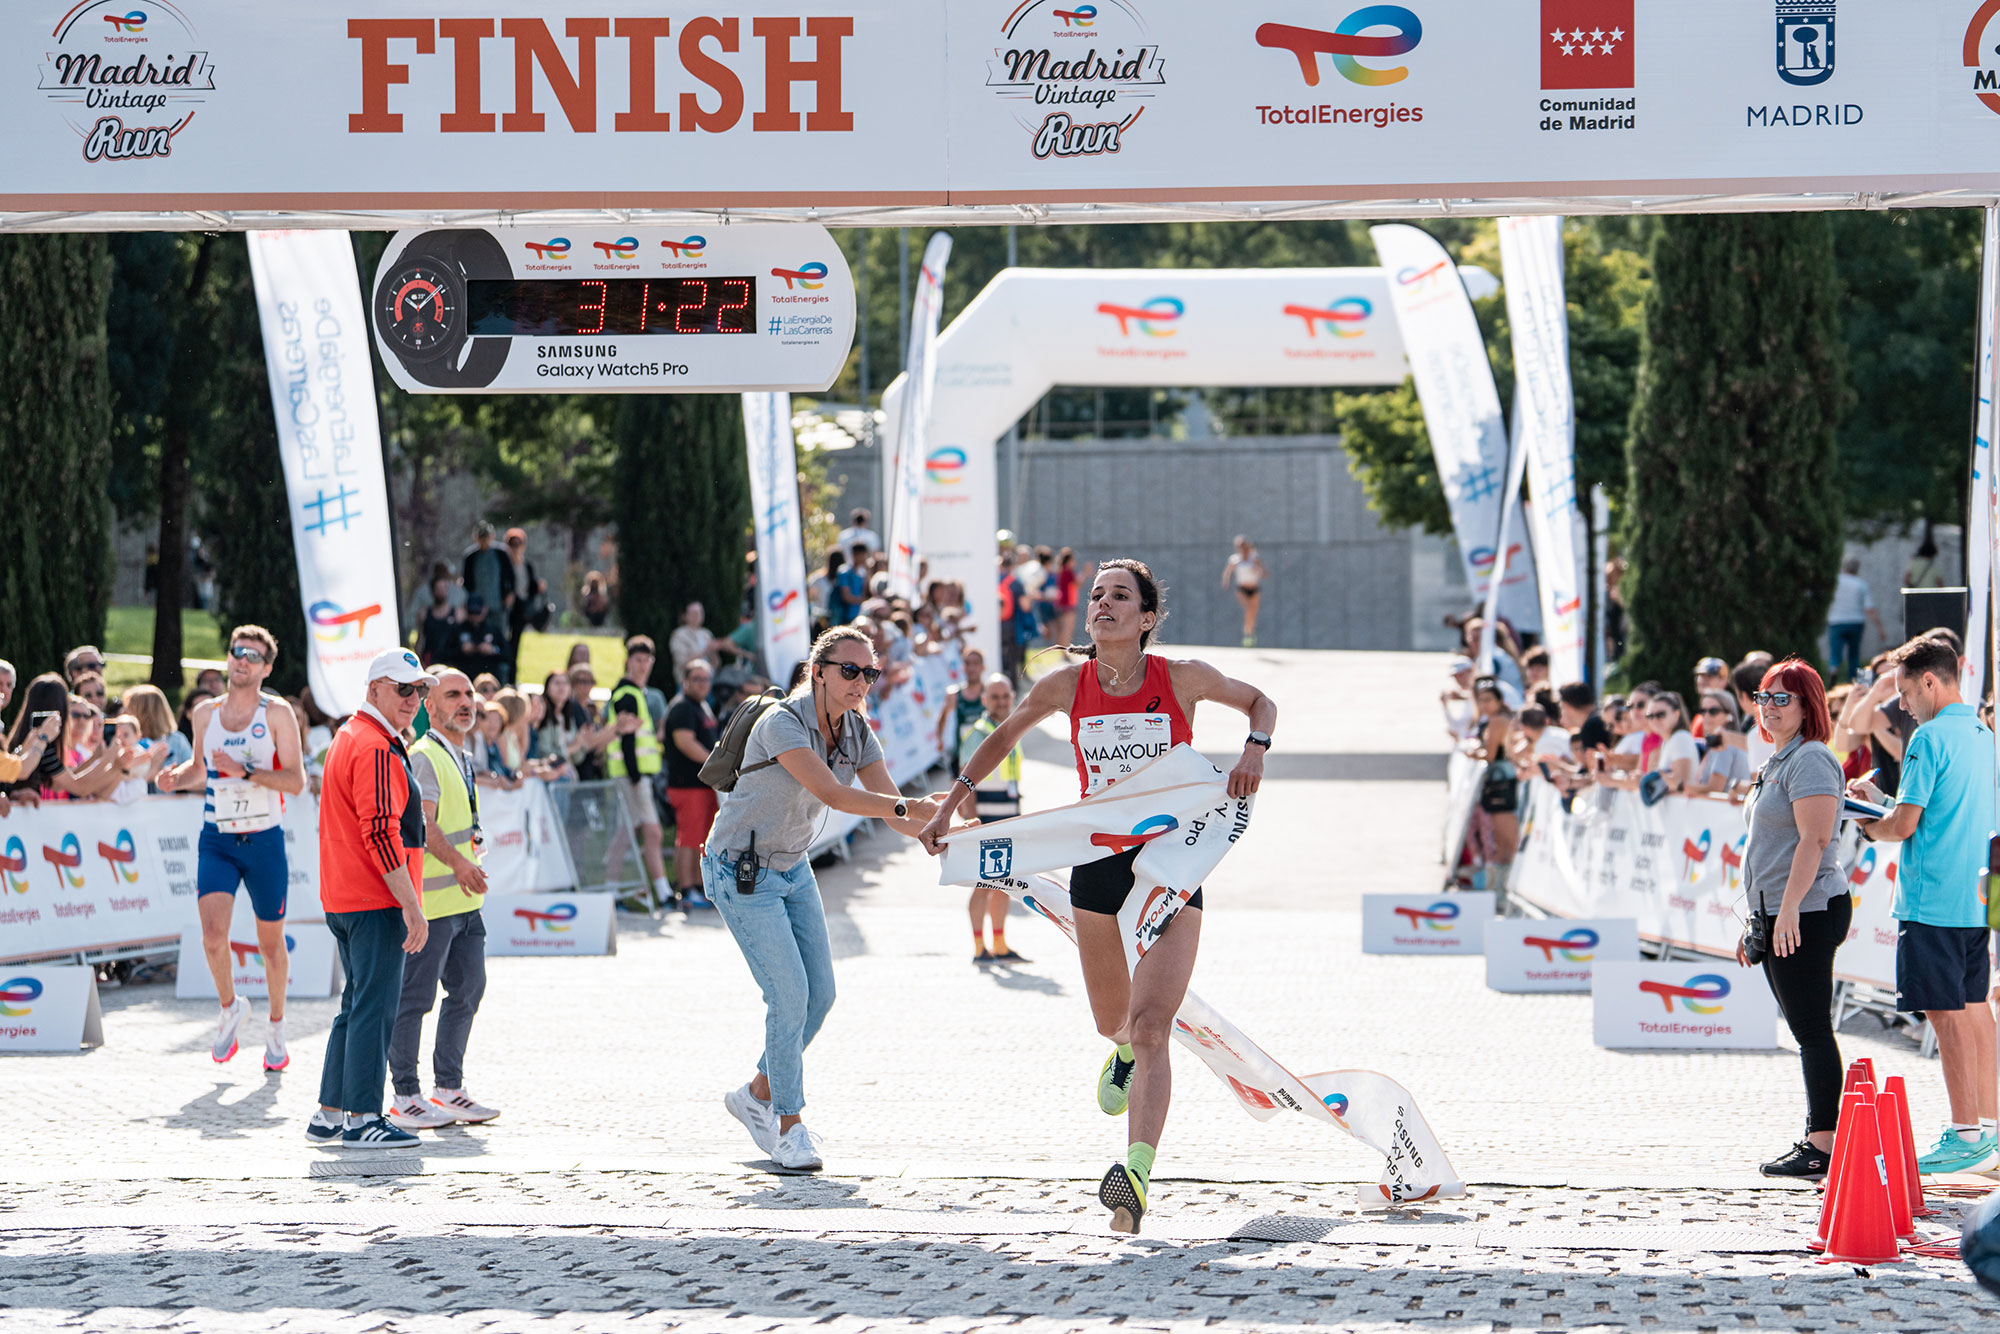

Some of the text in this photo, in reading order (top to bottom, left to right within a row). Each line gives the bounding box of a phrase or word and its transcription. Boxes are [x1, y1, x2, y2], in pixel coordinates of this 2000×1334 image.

[55, 53, 198, 87] Madrid
[1003, 48, 1148, 82] Madrid
[347, 16, 854, 133] FINISH
[1973, 70, 2000, 89] M
[86, 88, 167, 113] Vintage
[1035, 84, 1117, 109] Vintage
[1539, 97, 1636, 112] Comunidad
[1255, 102, 1423, 129] TotalEnergies
[1539, 114, 1636, 131] de Madrid
[1747, 104, 1864, 127] MADRID
[83, 115, 171, 163] Run
[1031, 111, 1122, 160] Run
[525, 264, 572, 272] TotalEnergies
[593, 263, 640, 271] TotalEnergies
[661, 262, 707, 270] TotalEnergies
[771, 295, 829, 305] TotalEnergies
[783, 325, 833, 335] LasCarreras
[537, 345, 617, 358] SAMSUNG
[536, 362, 689, 380] Galaxy Watch5 Pro
[1083, 743, 1168, 761] MAAYOUF
[1119, 763, 1132, 773] 26
[233, 800, 249, 813] 77
[1184, 819, 1206, 847] Pro
[1524, 969, 1593, 982] TotalEnergi
[1638, 1022, 1732, 1037] TotalEnergies
